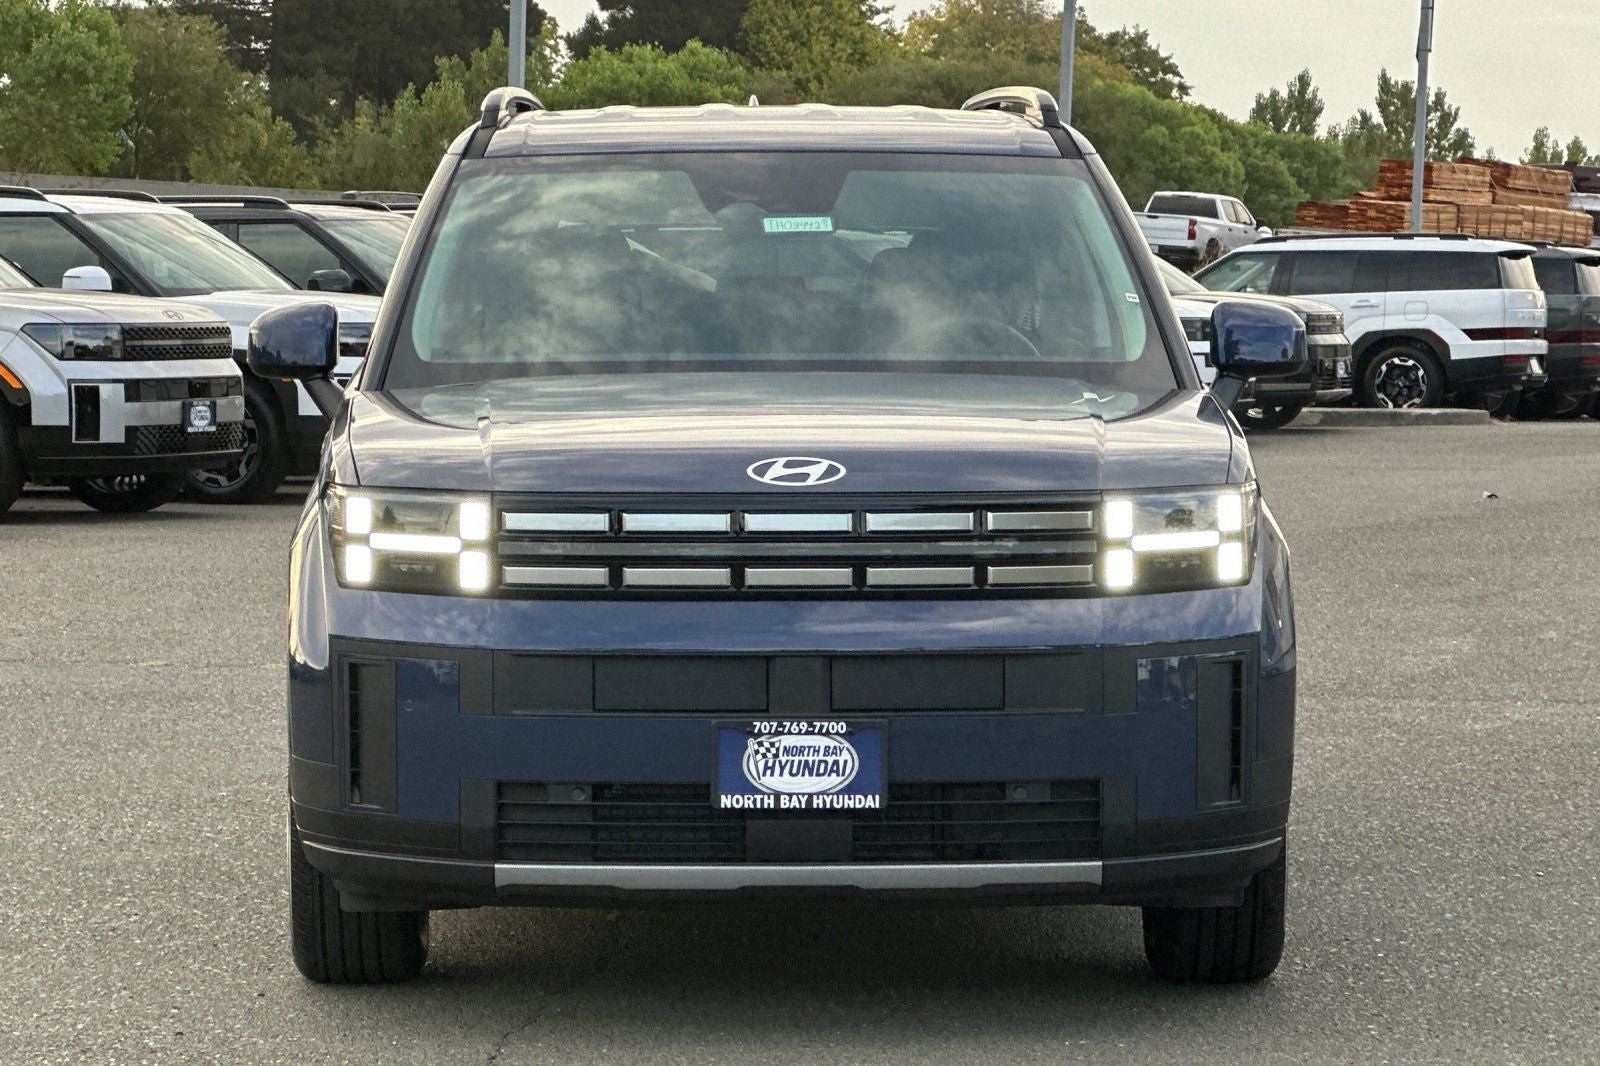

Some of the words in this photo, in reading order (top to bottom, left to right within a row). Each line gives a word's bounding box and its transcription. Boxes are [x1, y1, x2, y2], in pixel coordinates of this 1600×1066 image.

[753, 722, 847, 734] 707-769-7700
[782, 745, 820, 757] NORTH
[822, 745, 846, 757] BAY
[762, 759, 849, 777] HYUNDAI
[720, 794, 774, 809] NORTH
[780, 794, 808, 809] BAY
[812, 794, 880, 809] HYUNDAI
